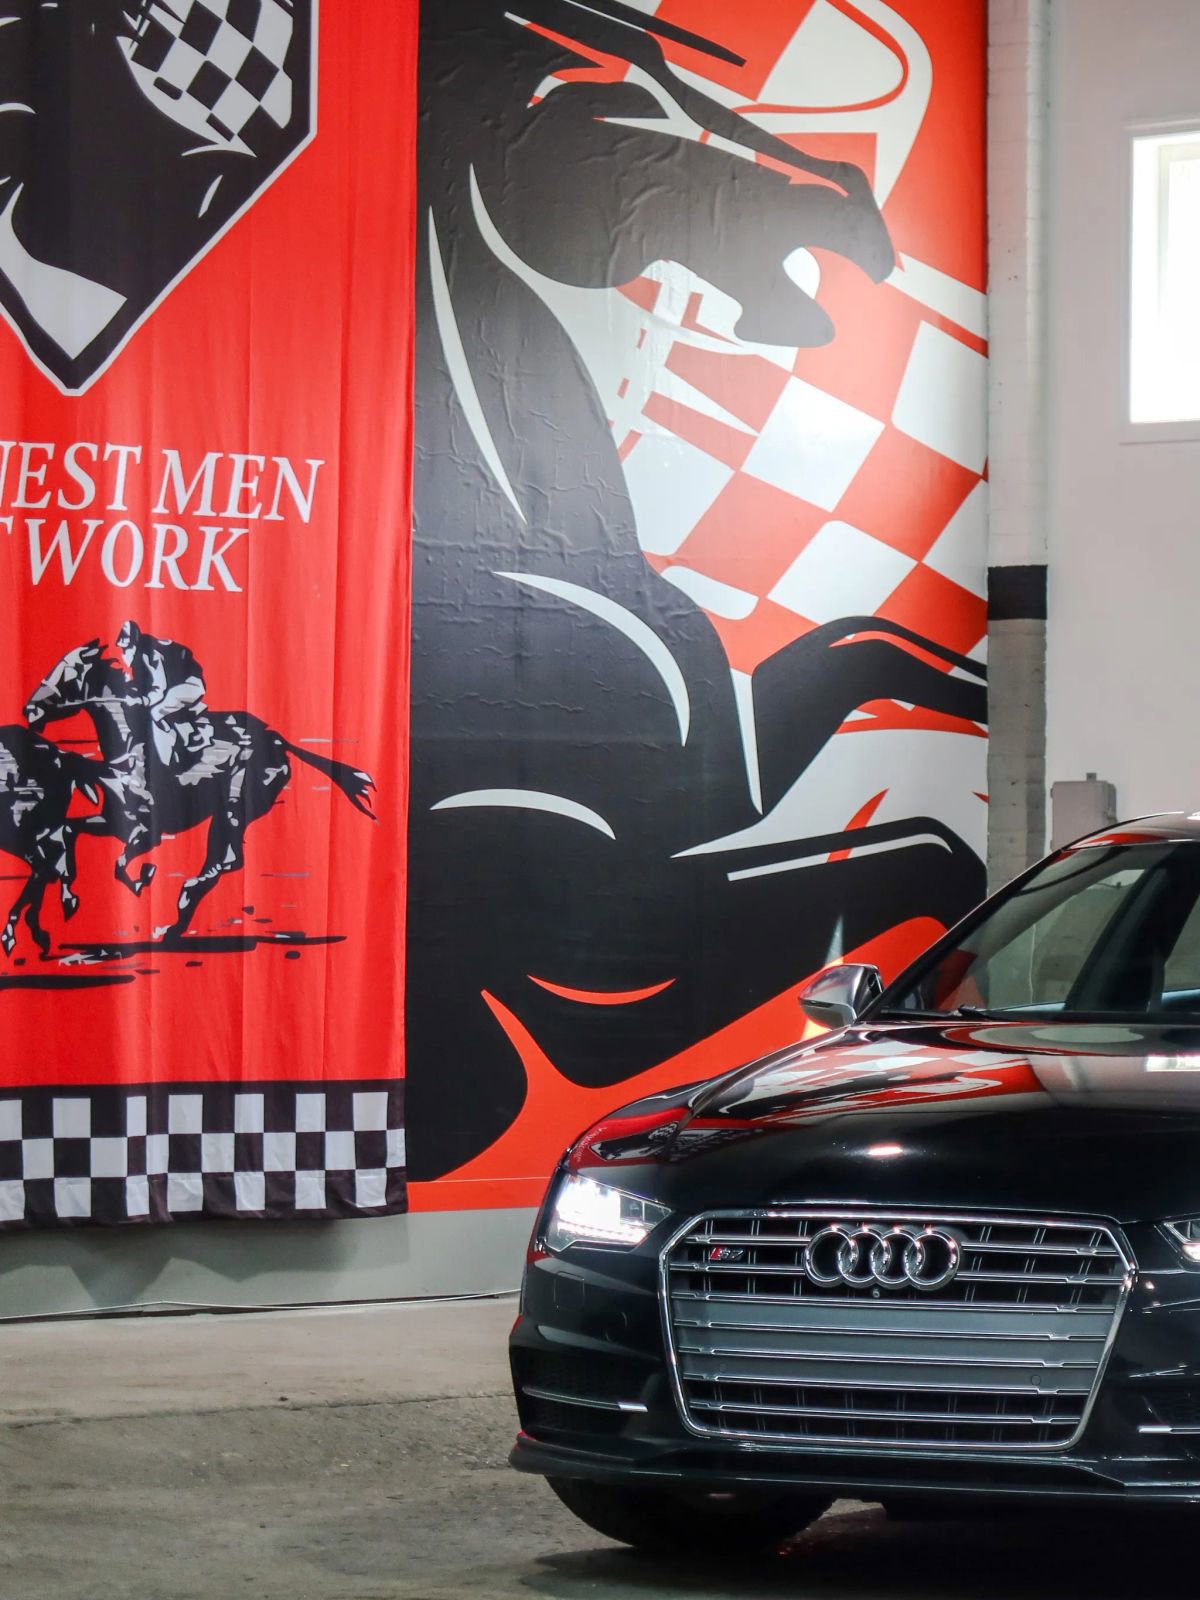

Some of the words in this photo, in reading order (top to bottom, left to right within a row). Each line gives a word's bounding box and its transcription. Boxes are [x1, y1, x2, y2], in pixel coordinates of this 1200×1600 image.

[0, 440, 143, 512] EST
[151, 448, 326, 524] MEN
[24, 517, 250, 593] WORK
